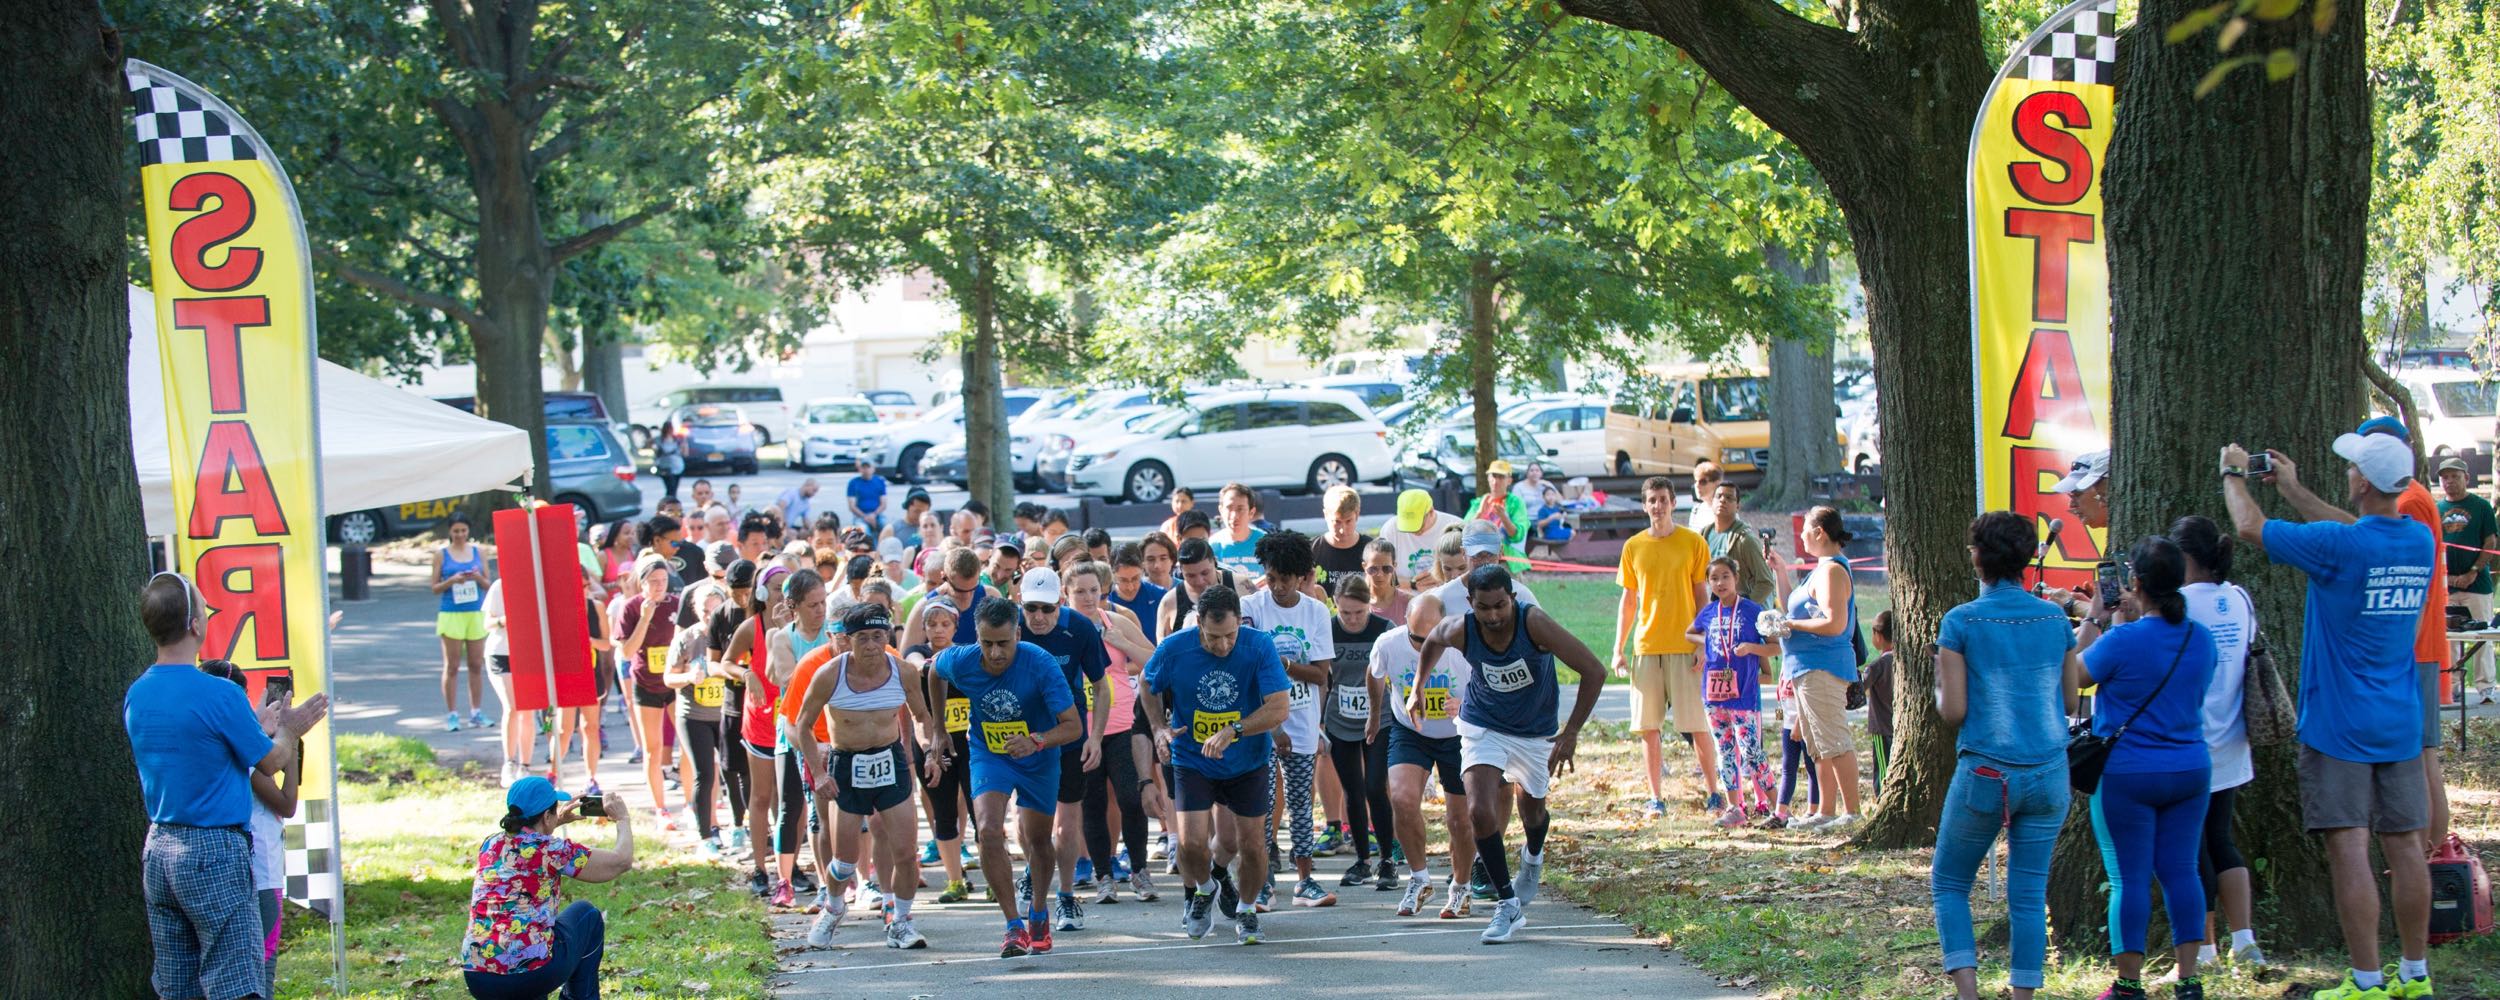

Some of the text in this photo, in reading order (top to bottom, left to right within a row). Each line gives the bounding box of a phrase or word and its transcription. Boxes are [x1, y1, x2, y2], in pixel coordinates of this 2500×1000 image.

[2368, 565, 2431, 577] SRI CHINMOY
[2366, 576, 2429, 588] MARATHON
[2364, 588, 2424, 609] TEAM
[1486, 668, 1528, 685] C409
[696, 685, 725, 700] T93
[1290, 680, 1310, 700] 434
[1711, 679, 1732, 692] 773
[1340, 694, 1369, 711] H42
[986, 730, 1026, 745] N9
